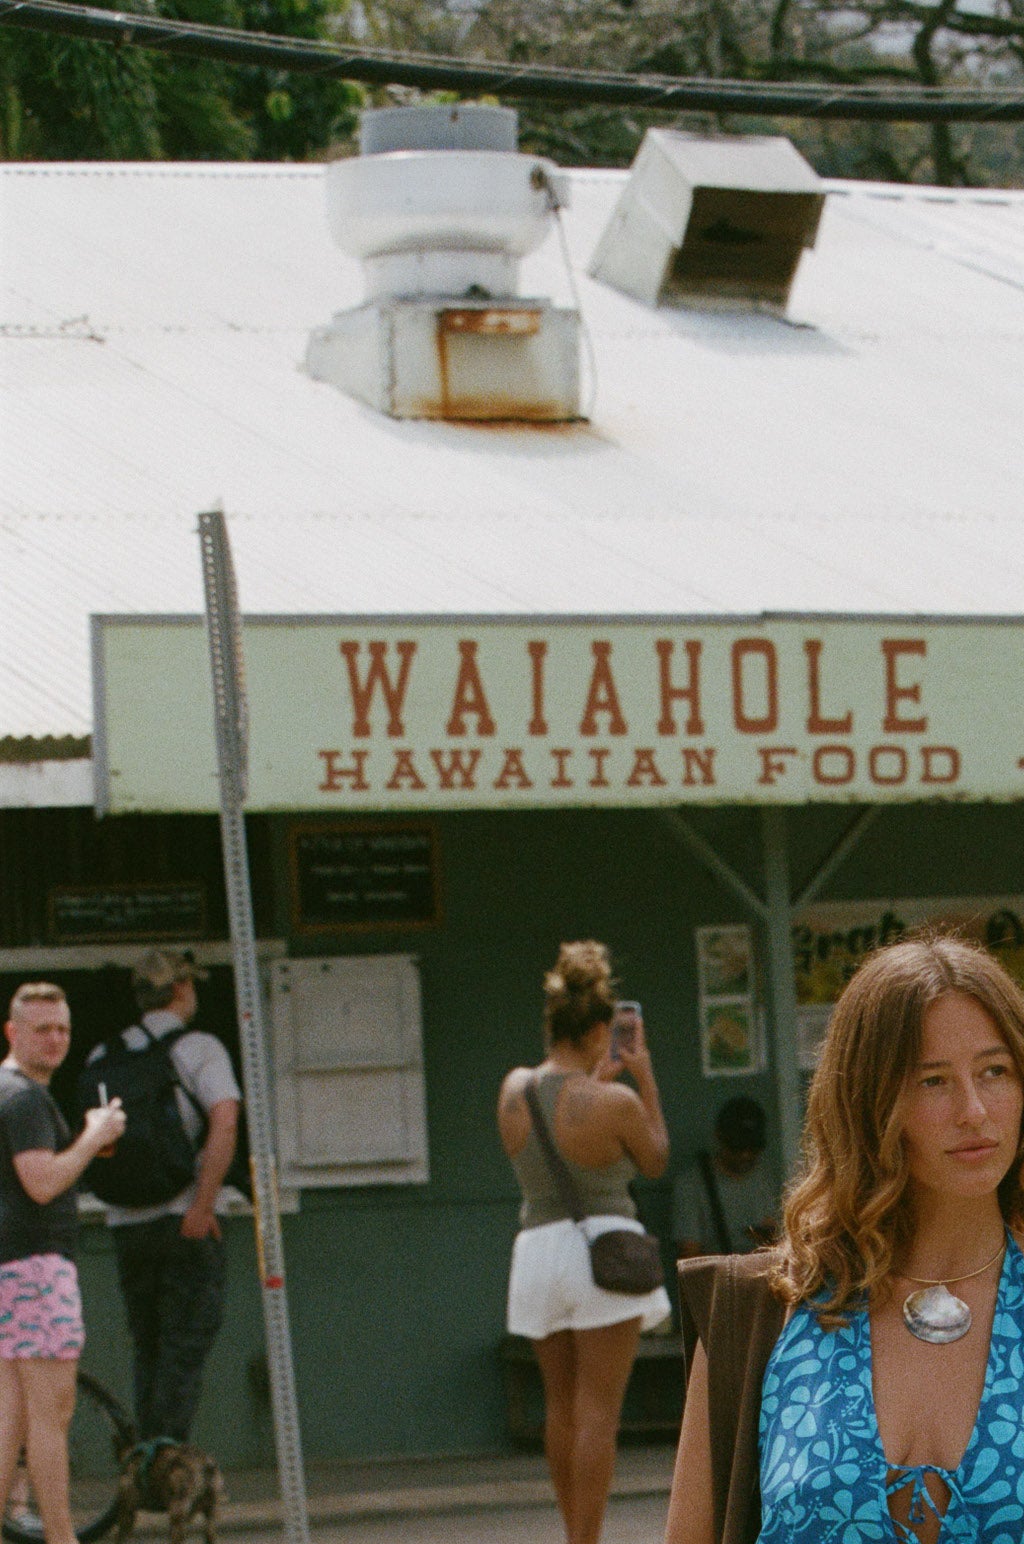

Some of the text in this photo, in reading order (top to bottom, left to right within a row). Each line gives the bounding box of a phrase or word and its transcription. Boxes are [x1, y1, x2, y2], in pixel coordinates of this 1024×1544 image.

[340, 638, 929, 741] WAIAHOLE
[318, 746, 717, 793] HAWAIIAN
[757, 743, 962, 787] FOOD
